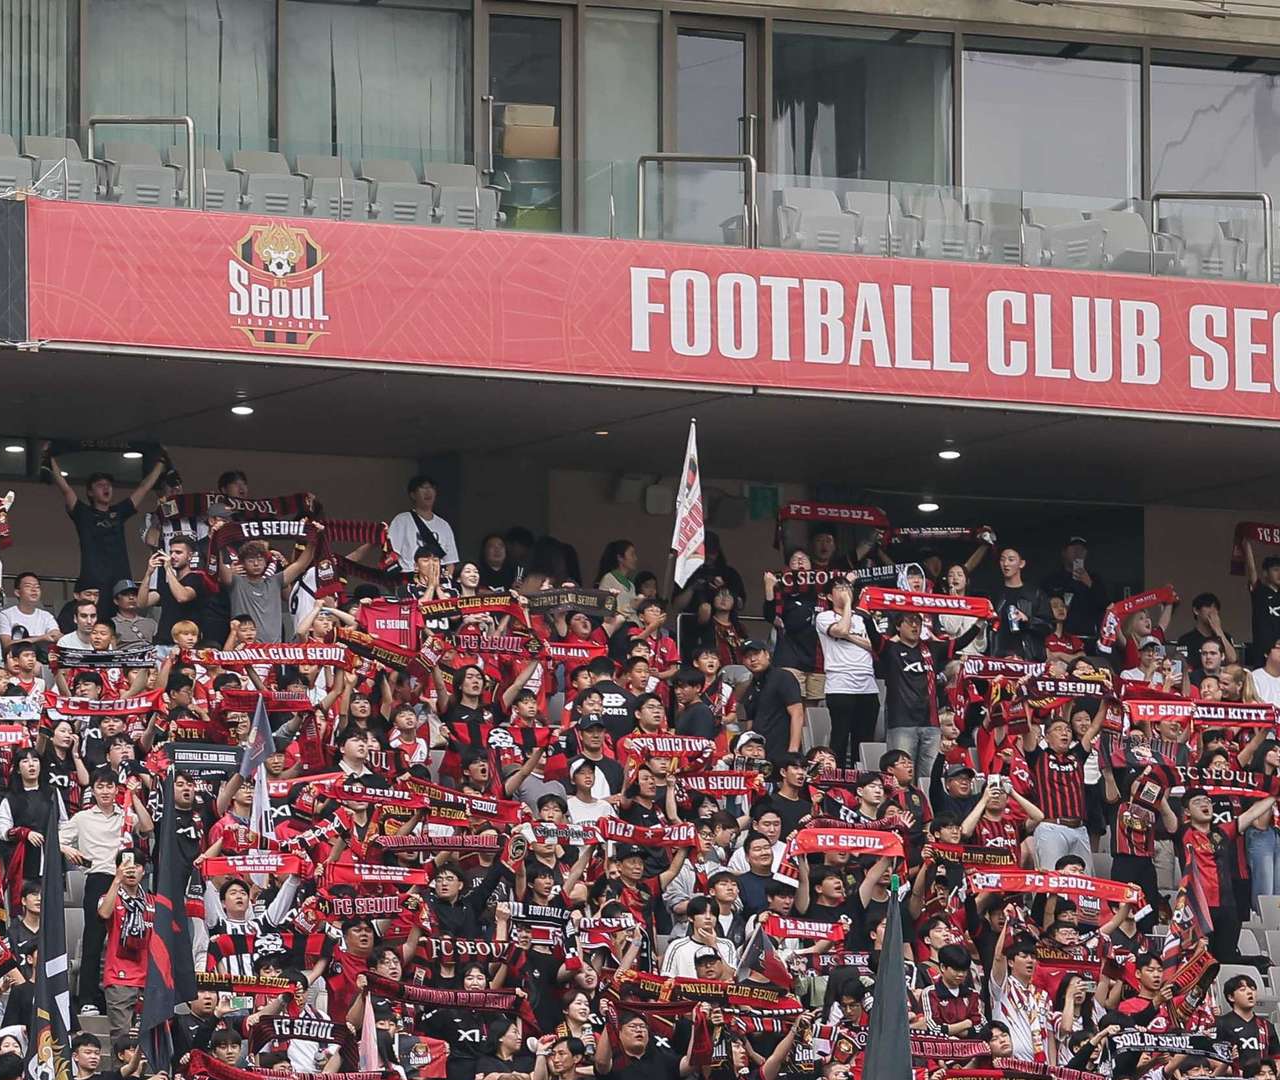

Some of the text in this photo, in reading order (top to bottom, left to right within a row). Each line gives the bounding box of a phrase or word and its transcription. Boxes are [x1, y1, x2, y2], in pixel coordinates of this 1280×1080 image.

[228, 258, 331, 321] Seoul
[629, 265, 1280, 393] FOOTBALL CLUB SE
[241, 521, 309, 537] FC SEOUL
[1037, 680, 1103, 696] FC SEOUL
[1137, 705, 1156, 717] FC
[1228, 708, 1268, 722] KITTY
[817, 834, 883, 850] FC SEOUL
[1025, 876, 1096, 891] FC SEOUL
[333, 896, 403, 915] FC SEOUL
[680, 983, 778, 1003] FOOTBALL CLUB SEOUL
[274, 1019, 334, 1040] FC SEOUL
